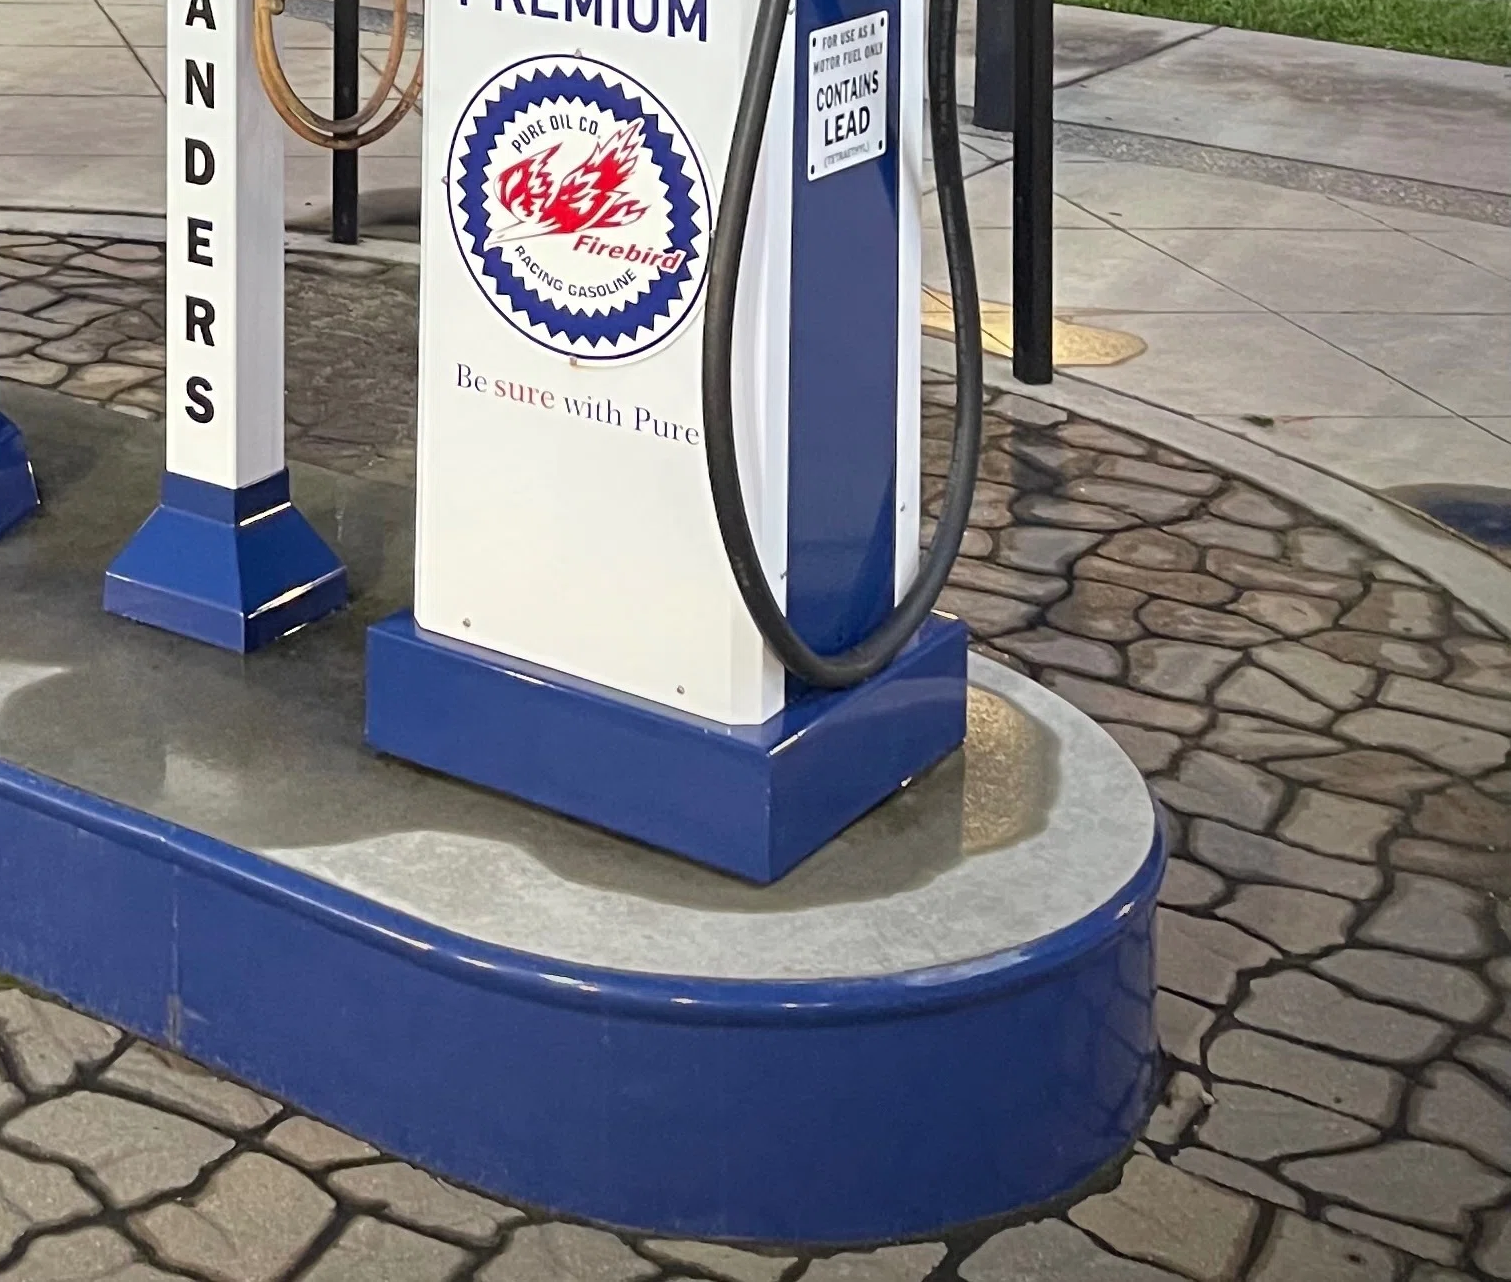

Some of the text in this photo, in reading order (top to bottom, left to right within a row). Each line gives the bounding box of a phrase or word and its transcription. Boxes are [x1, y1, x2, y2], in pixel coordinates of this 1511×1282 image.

[822, 23, 876, 51] FOR USE AS A
[813, 42, 883, 75] MOTOR FUEL ONLY
[817, 70, 879, 112] CONTAINS
[511, 119, 547, 154] PURE
[549, 114, 572, 131] OIL
[824, 106, 870, 147] LEAD
[515, 245, 637, 298] RACING GASOLINE
[573, 235, 681, 270] Firebird
[456, 363, 701, 446] Be sure with Pure
